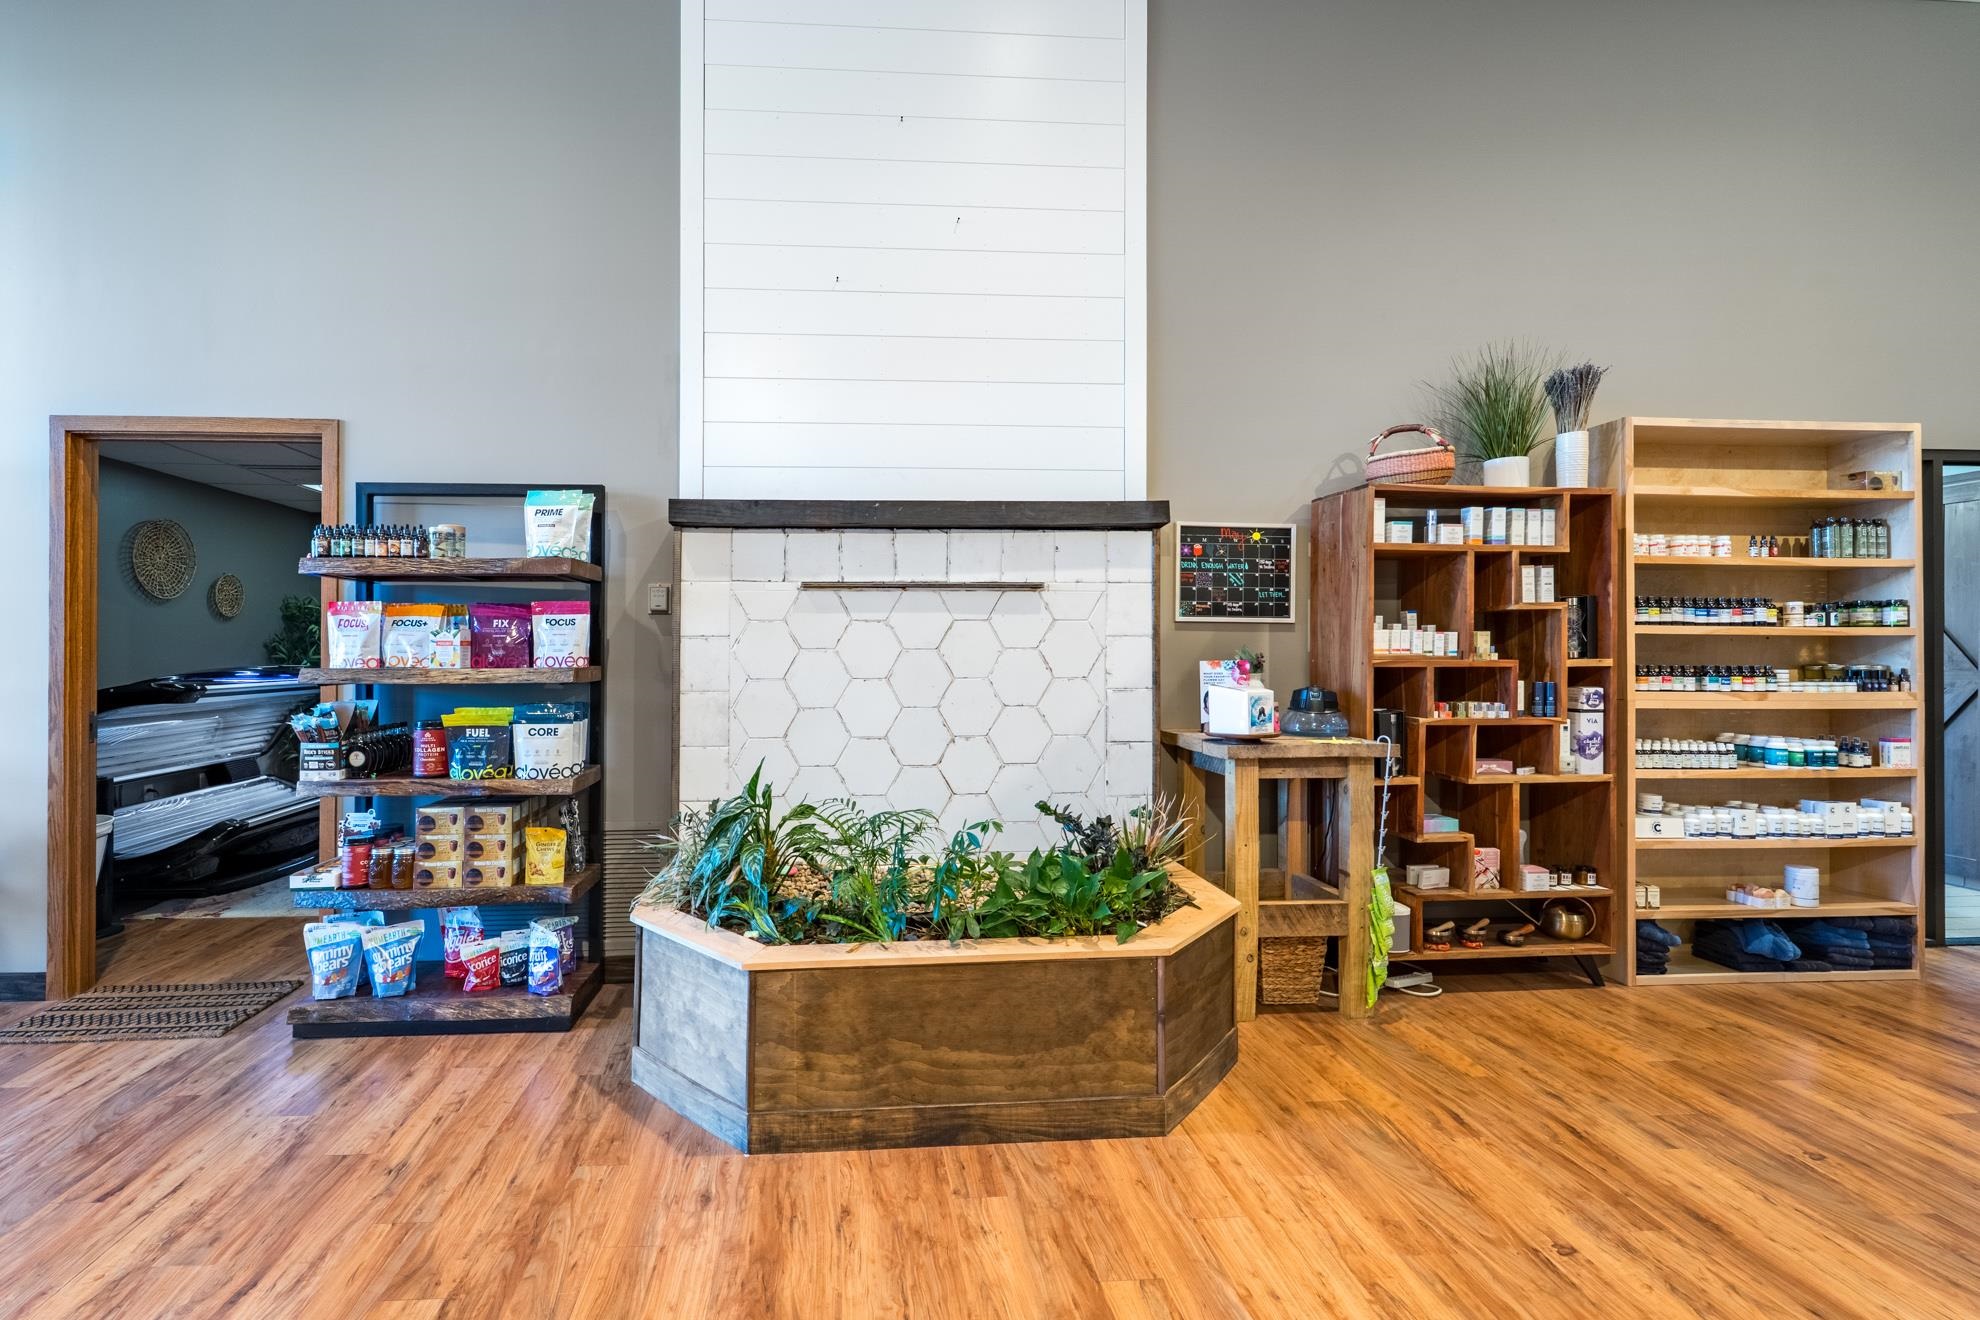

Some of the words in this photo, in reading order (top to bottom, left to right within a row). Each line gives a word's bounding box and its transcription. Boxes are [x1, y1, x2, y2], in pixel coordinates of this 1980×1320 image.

[535, 508, 563, 516] PRIME
[1220, 528, 1247, 551] May
[1181, 561, 1198, 569] DRINK
[1201, 561, 1224, 570] ENOUGH
[1226, 562, 1244, 570] WATER
[391, 619, 428, 627] FOCUS+
[493, 620, 509, 628] FIX
[545, 618, 576, 627] FOCUS
[465, 728, 490, 737] FUEL
[528, 727, 559, 737] CORE
